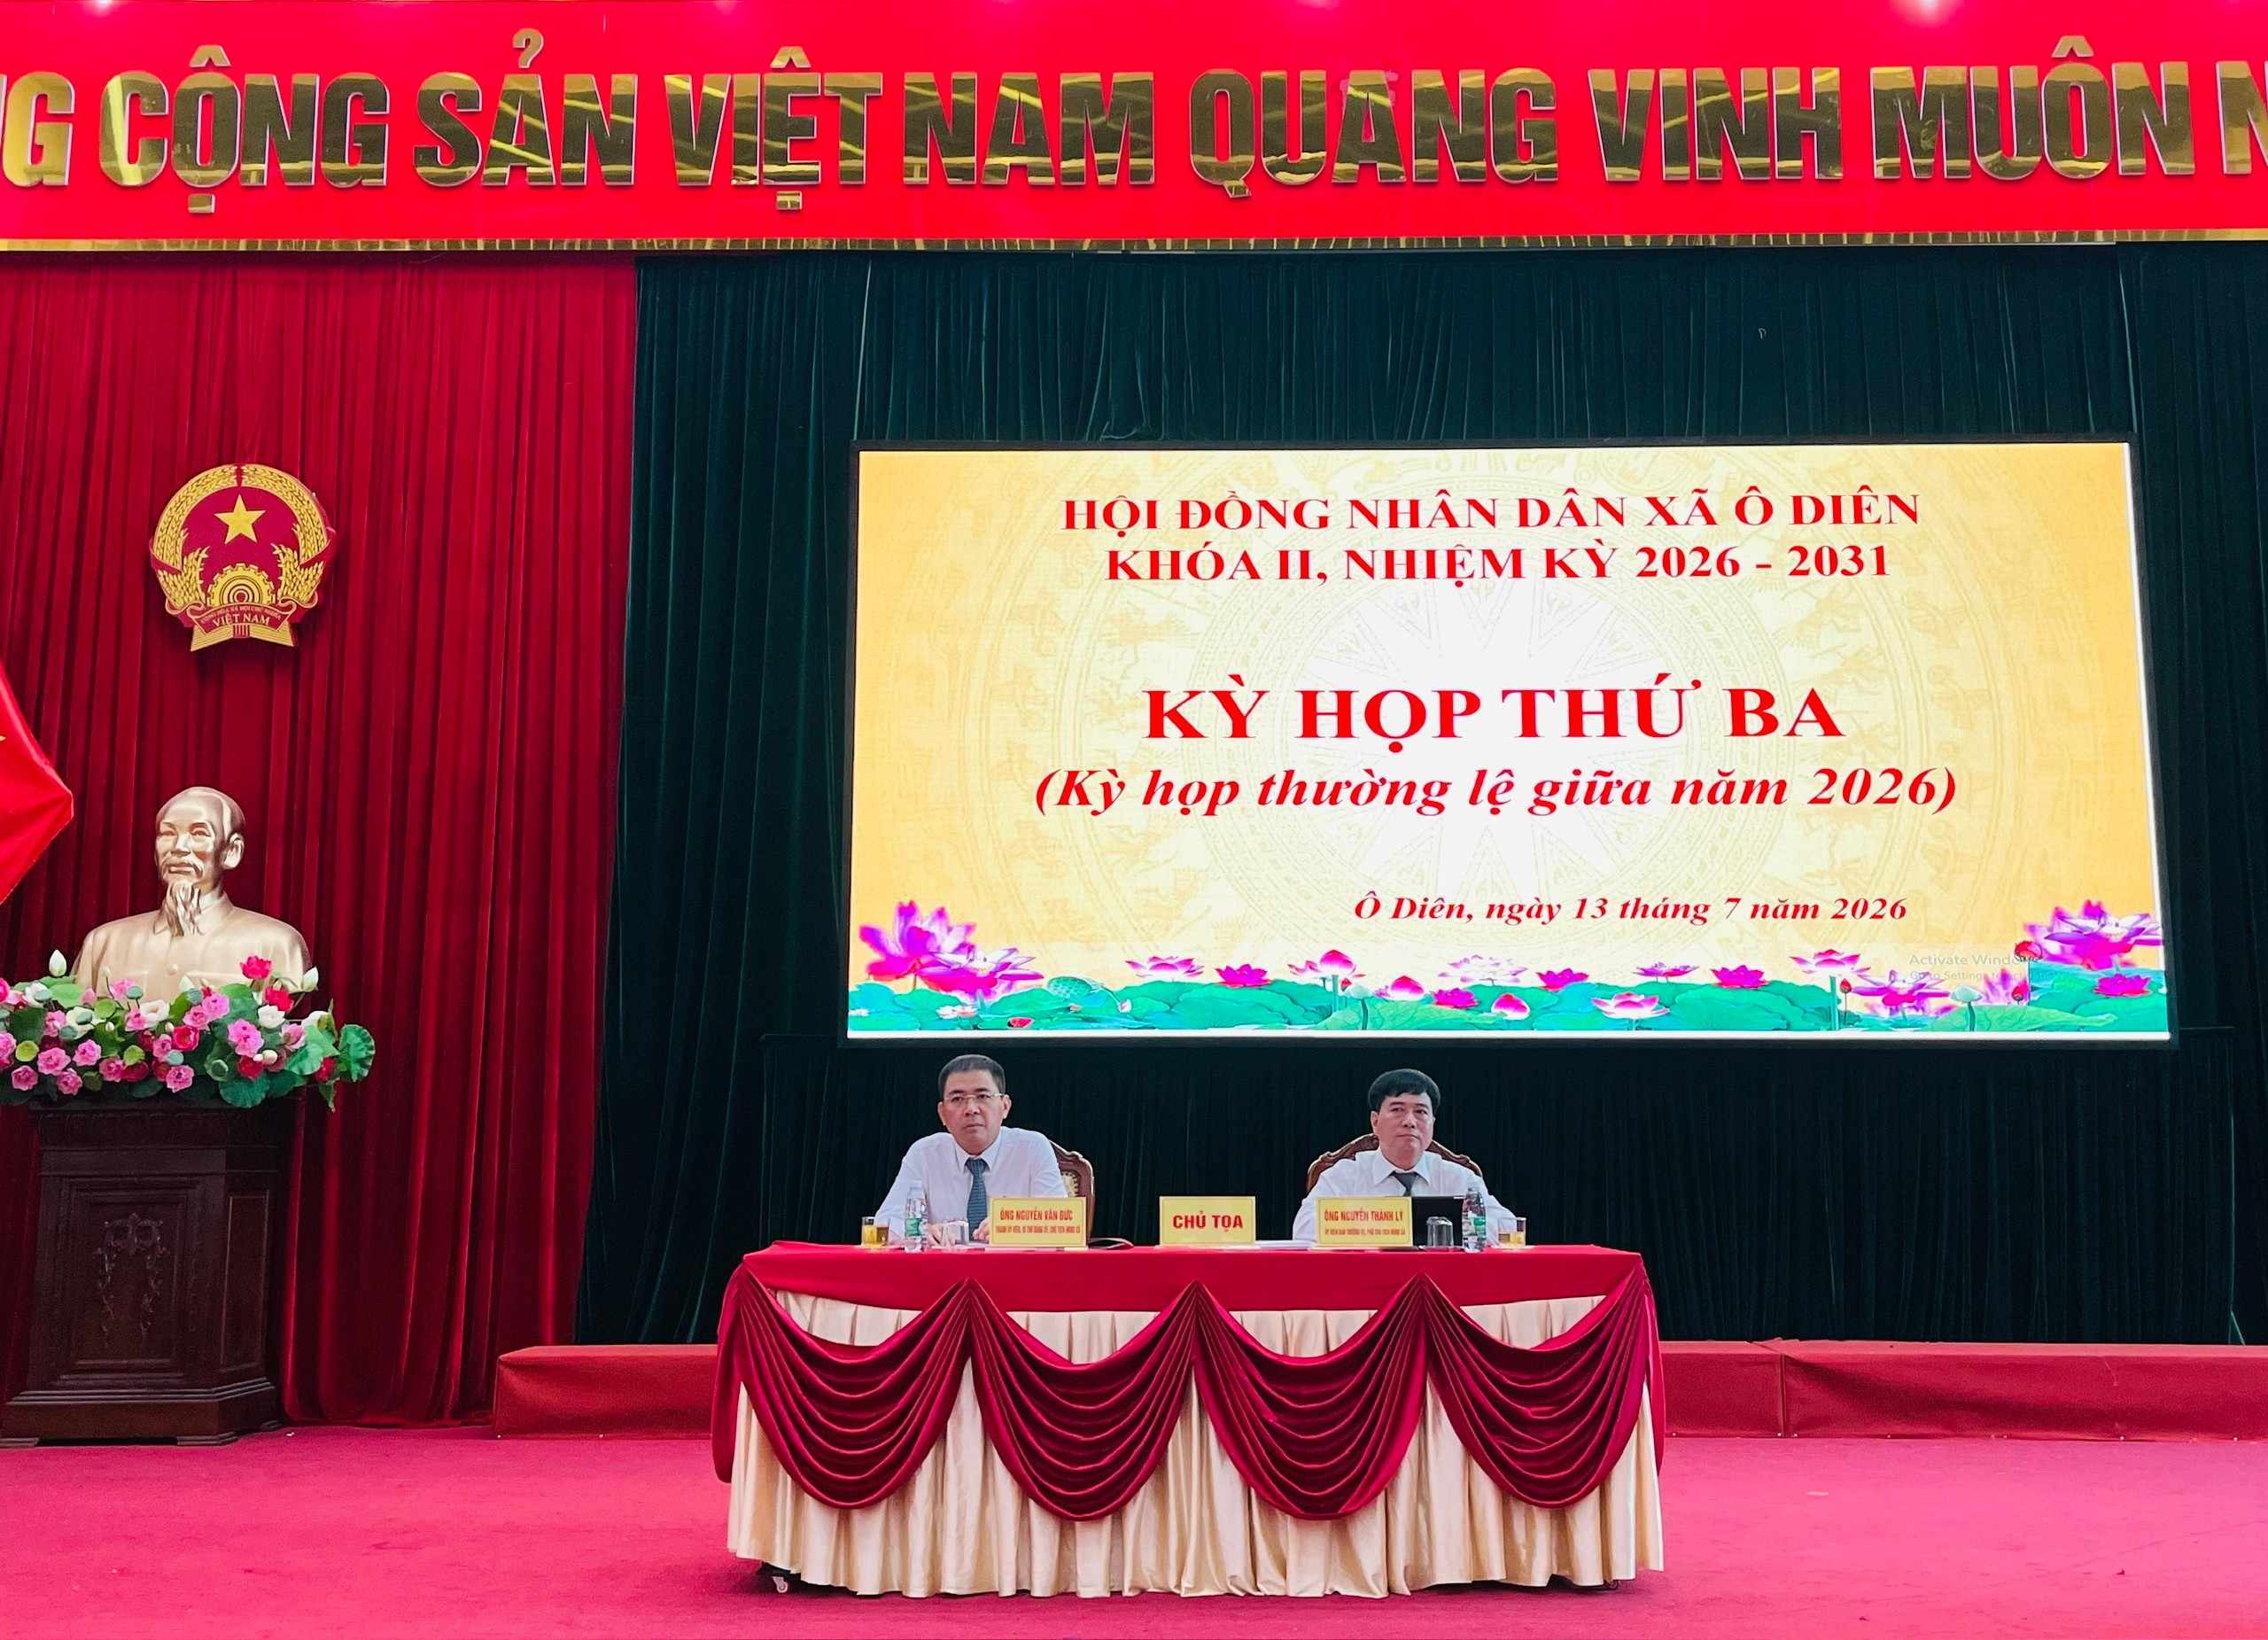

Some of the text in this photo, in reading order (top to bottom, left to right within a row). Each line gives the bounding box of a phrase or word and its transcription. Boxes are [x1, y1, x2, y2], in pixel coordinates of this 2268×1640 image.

[0, 71, 74, 187] G
[99, 45, 390, 214] CỘNG
[414, 27, 637, 186] SẢN
[664, 46, 882, 210] VIỆT
[904, 71, 1155, 186] NAM
[1190, 67, 1558, 198] QUANG
[1588, 67, 1843, 182] VINH
[1870, 35, 2195, 181] MUÔN
[1061, 485, 1919, 538] HỘI ĐỒNG NHÂN DÂN XÃ Ô DIÊN
[1106, 540, 1263, 581] KHÓA
[1276, 549, 1328, 585] II,
[1344, 544, 1525, 588] NHIỆM
[1542, 539, 1619, 579] KỲ
[1635, 546, 1740, 578] 2026
[1788, 545, 1890, 576] 2031
[243, 613, 270, 626] NAM
[1141, 673, 1846, 753] KỲ HỌP THỨ BA
[1036, 766, 1956, 817] (Kỳ họp thường lệ giữa năm 2026)
[1355, 890, 1907, 926] Ô Diên, ngày 13 tháng 7 năm 2026
[1909, 953, 1969, 965] Activate
[1172, 1209, 1244, 1232] CHỦ TỌA
